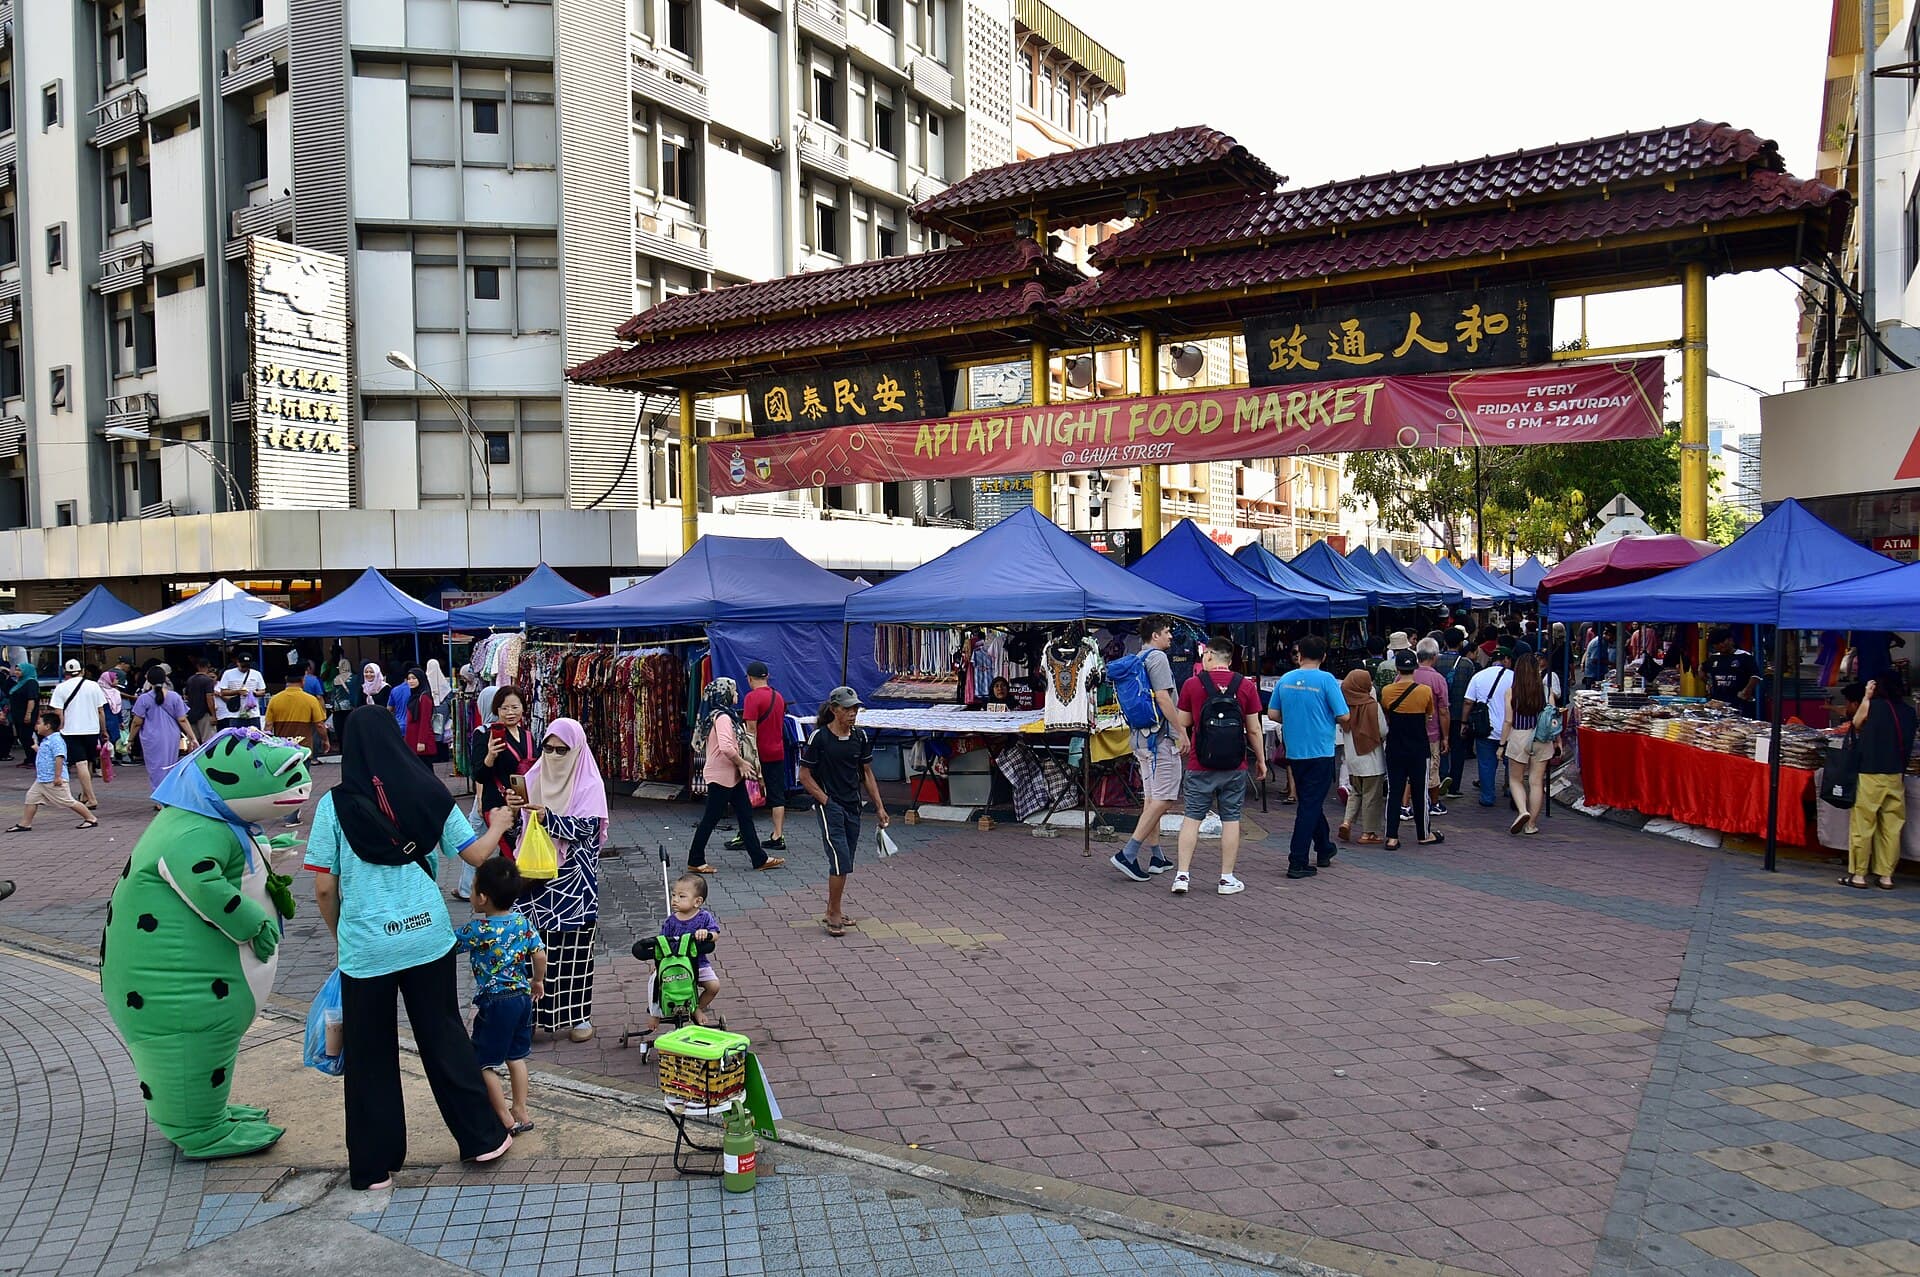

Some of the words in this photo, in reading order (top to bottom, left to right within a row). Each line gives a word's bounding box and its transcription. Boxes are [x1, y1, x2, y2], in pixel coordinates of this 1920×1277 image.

[1267, 303, 1509, 371] 政通人和
[764, 373, 906, 423] 國泰民安
[1526, 383, 1578, 398] EVERY
[1476, 401, 1531, 416] FRIDAY
[1533, 400, 1545, 413] &
[1547, 395, 1632, 412] SATURDAY
[914, 422, 959, 460] API
[965, 416, 1014, 456] API
[1021, 406, 1121, 447] NIGHT
[1128, 399, 1224, 443] FOOD
[1232, 382, 1385, 435] MARKET
[1505, 418, 1515, 430] 6
[1518, 416, 1542, 429] PM
[1555, 415, 1569, 427] 12
[1573, 413, 1599, 426] AM
[1061, 451, 1076, 467] @
[1080, 446, 1118, 466] GAYA
[1121, 442, 1175, 461] STREET
[1882, 538, 1912, 549] ATM
[402, 911, 430, 924] UNHCR
[405, 917, 432, 930] ACNUR
